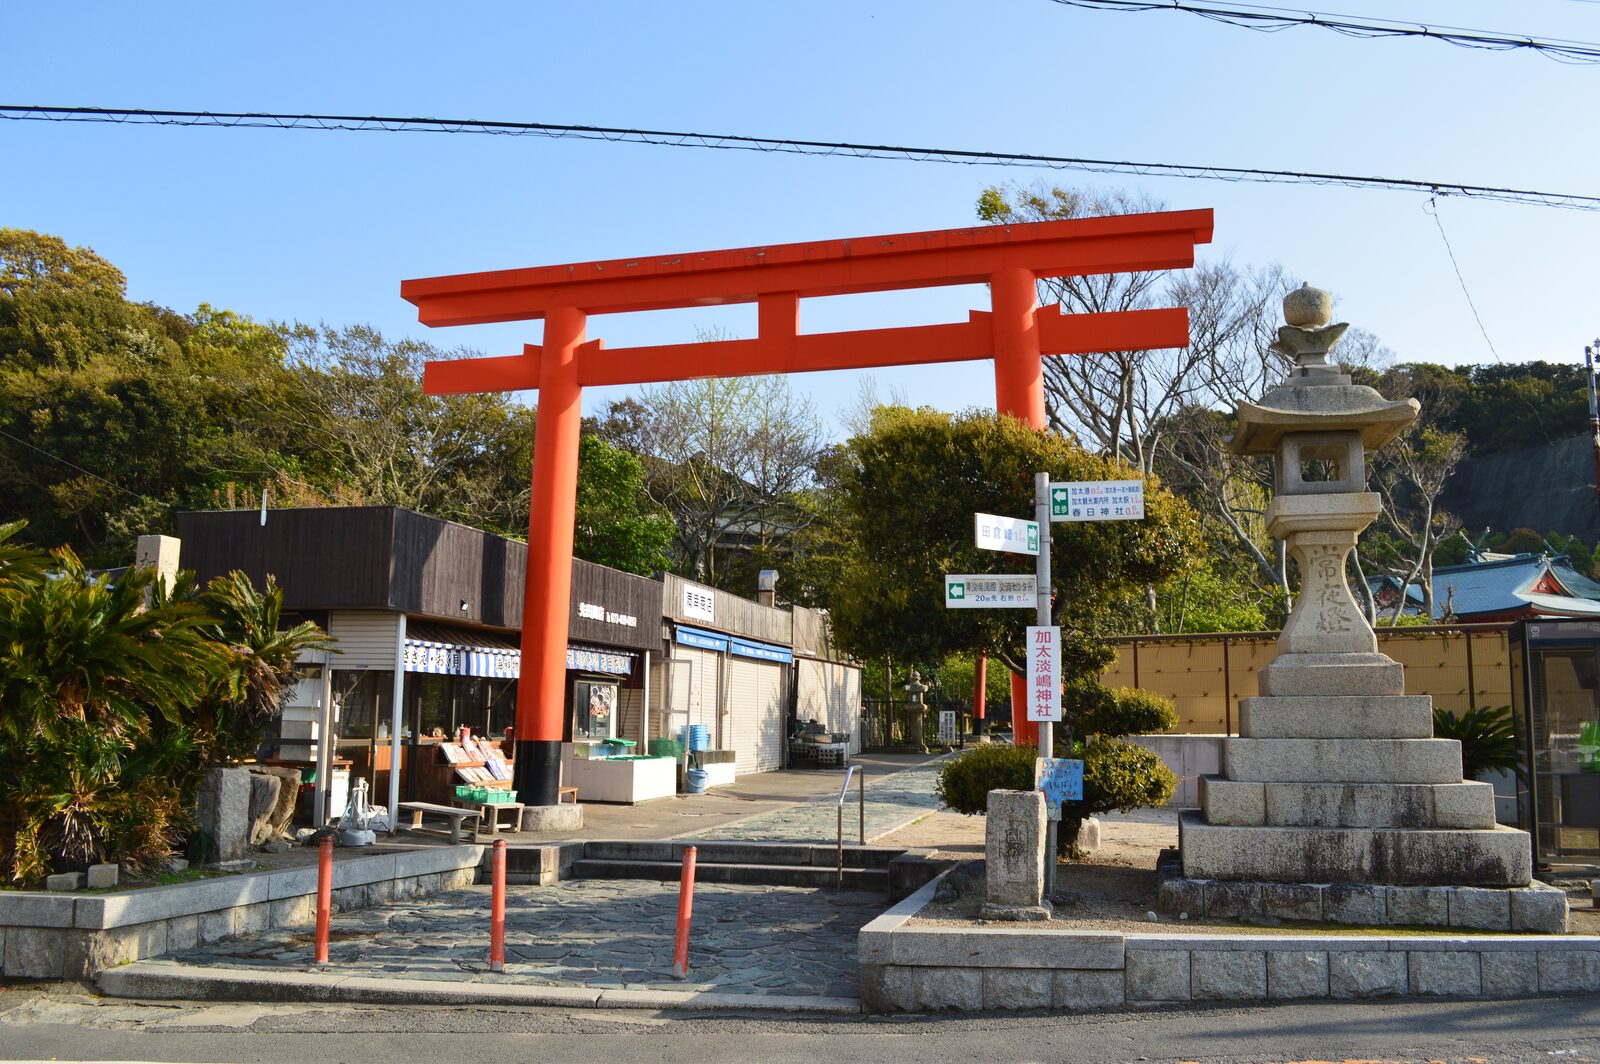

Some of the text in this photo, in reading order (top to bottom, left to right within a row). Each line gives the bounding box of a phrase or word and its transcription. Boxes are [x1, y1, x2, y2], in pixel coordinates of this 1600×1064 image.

[1073, 507, 1124, 517] 春日神社
[982, 525, 1013, 541] 田倉崎
[1035, 630, 1052, 717] 加太淡嶋神社
